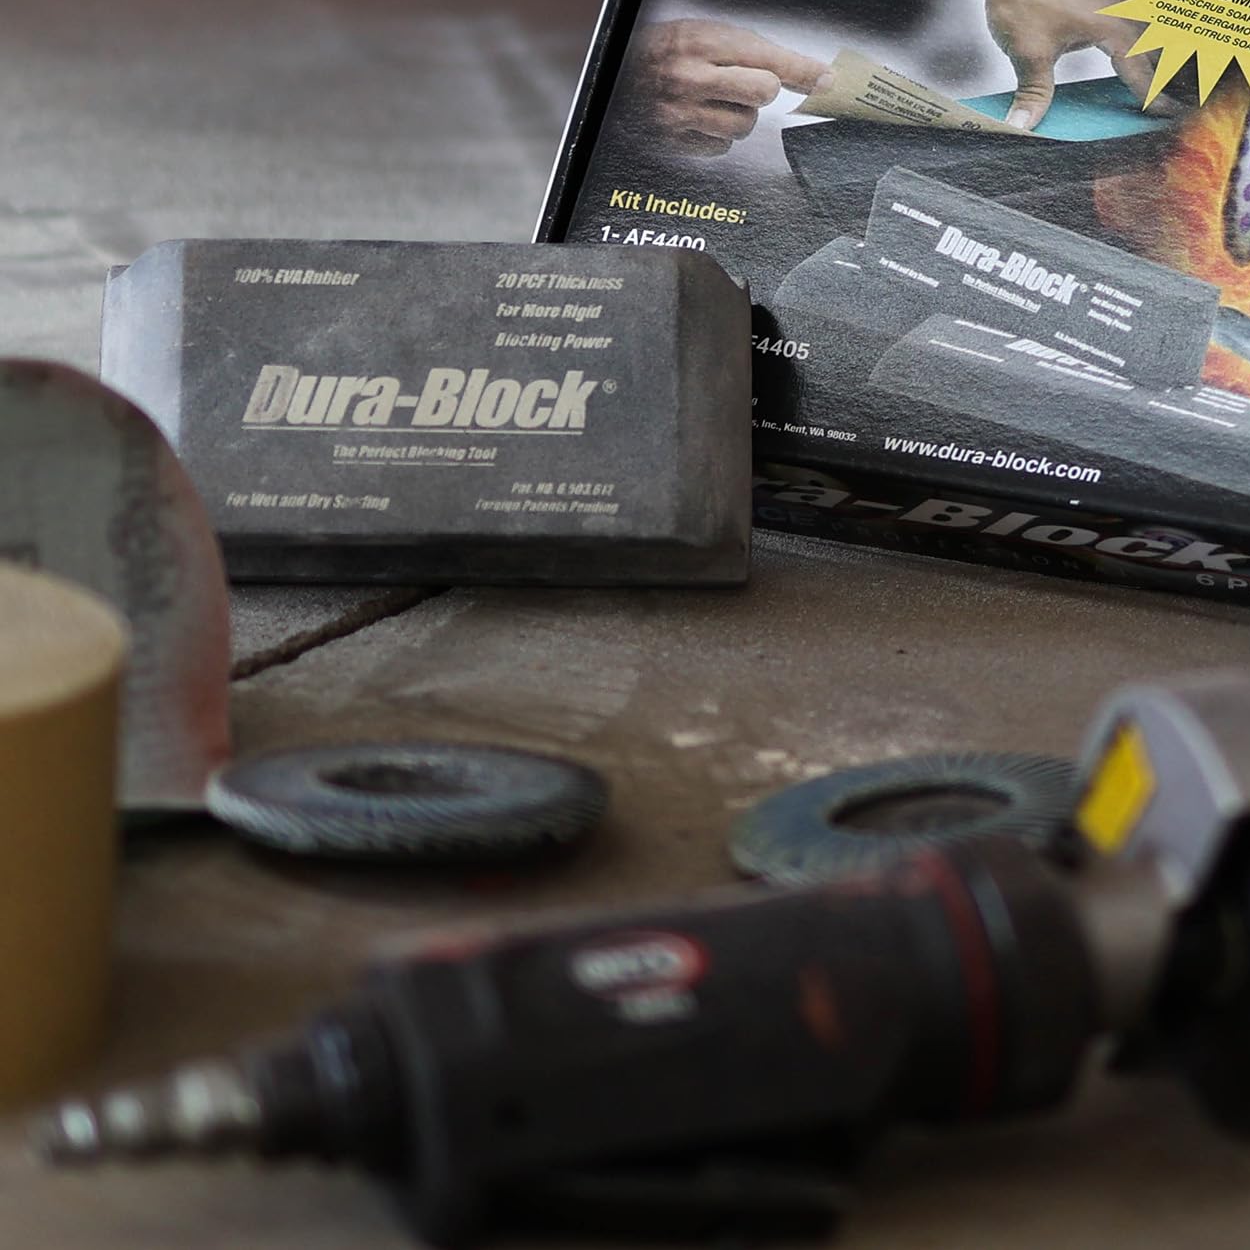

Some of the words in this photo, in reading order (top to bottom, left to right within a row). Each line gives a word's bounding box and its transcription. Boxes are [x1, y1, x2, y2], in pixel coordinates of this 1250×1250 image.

[1155, 0, 1200, 20] ORANGE
[1156, 15, 1192, 33] CEDAR
[1193, 26, 1232, 44] CITRUS
[609, 189, 642, 210] Kit
[645, 193, 748, 224] Includes:
[496, 273, 517, 288] 20
[517, 274, 548, 289] PCF
[496, 303, 520, 317] For
[521, 304, 561, 318] More
[561, 304, 602, 321] Rigid
[495, 332, 562, 351] Blocking
[563, 334, 613, 349] Power
[752, 334, 810, 360] 4405
[784, 422, 808, 436] Kent,
[809, 426, 824, 437] WA
[826, 429, 857, 442] 98032
[333, 444, 355, 458] The
[358, 445, 407, 459] Perfect
[467, 446, 497, 460] Tool
[884, 436, 1102, 485] www.dura-block.com
[225, 491, 248, 507] For
[249, 492, 278, 508] Wet
[278, 493, 307, 508] and
[307, 493, 332, 510] Dry
